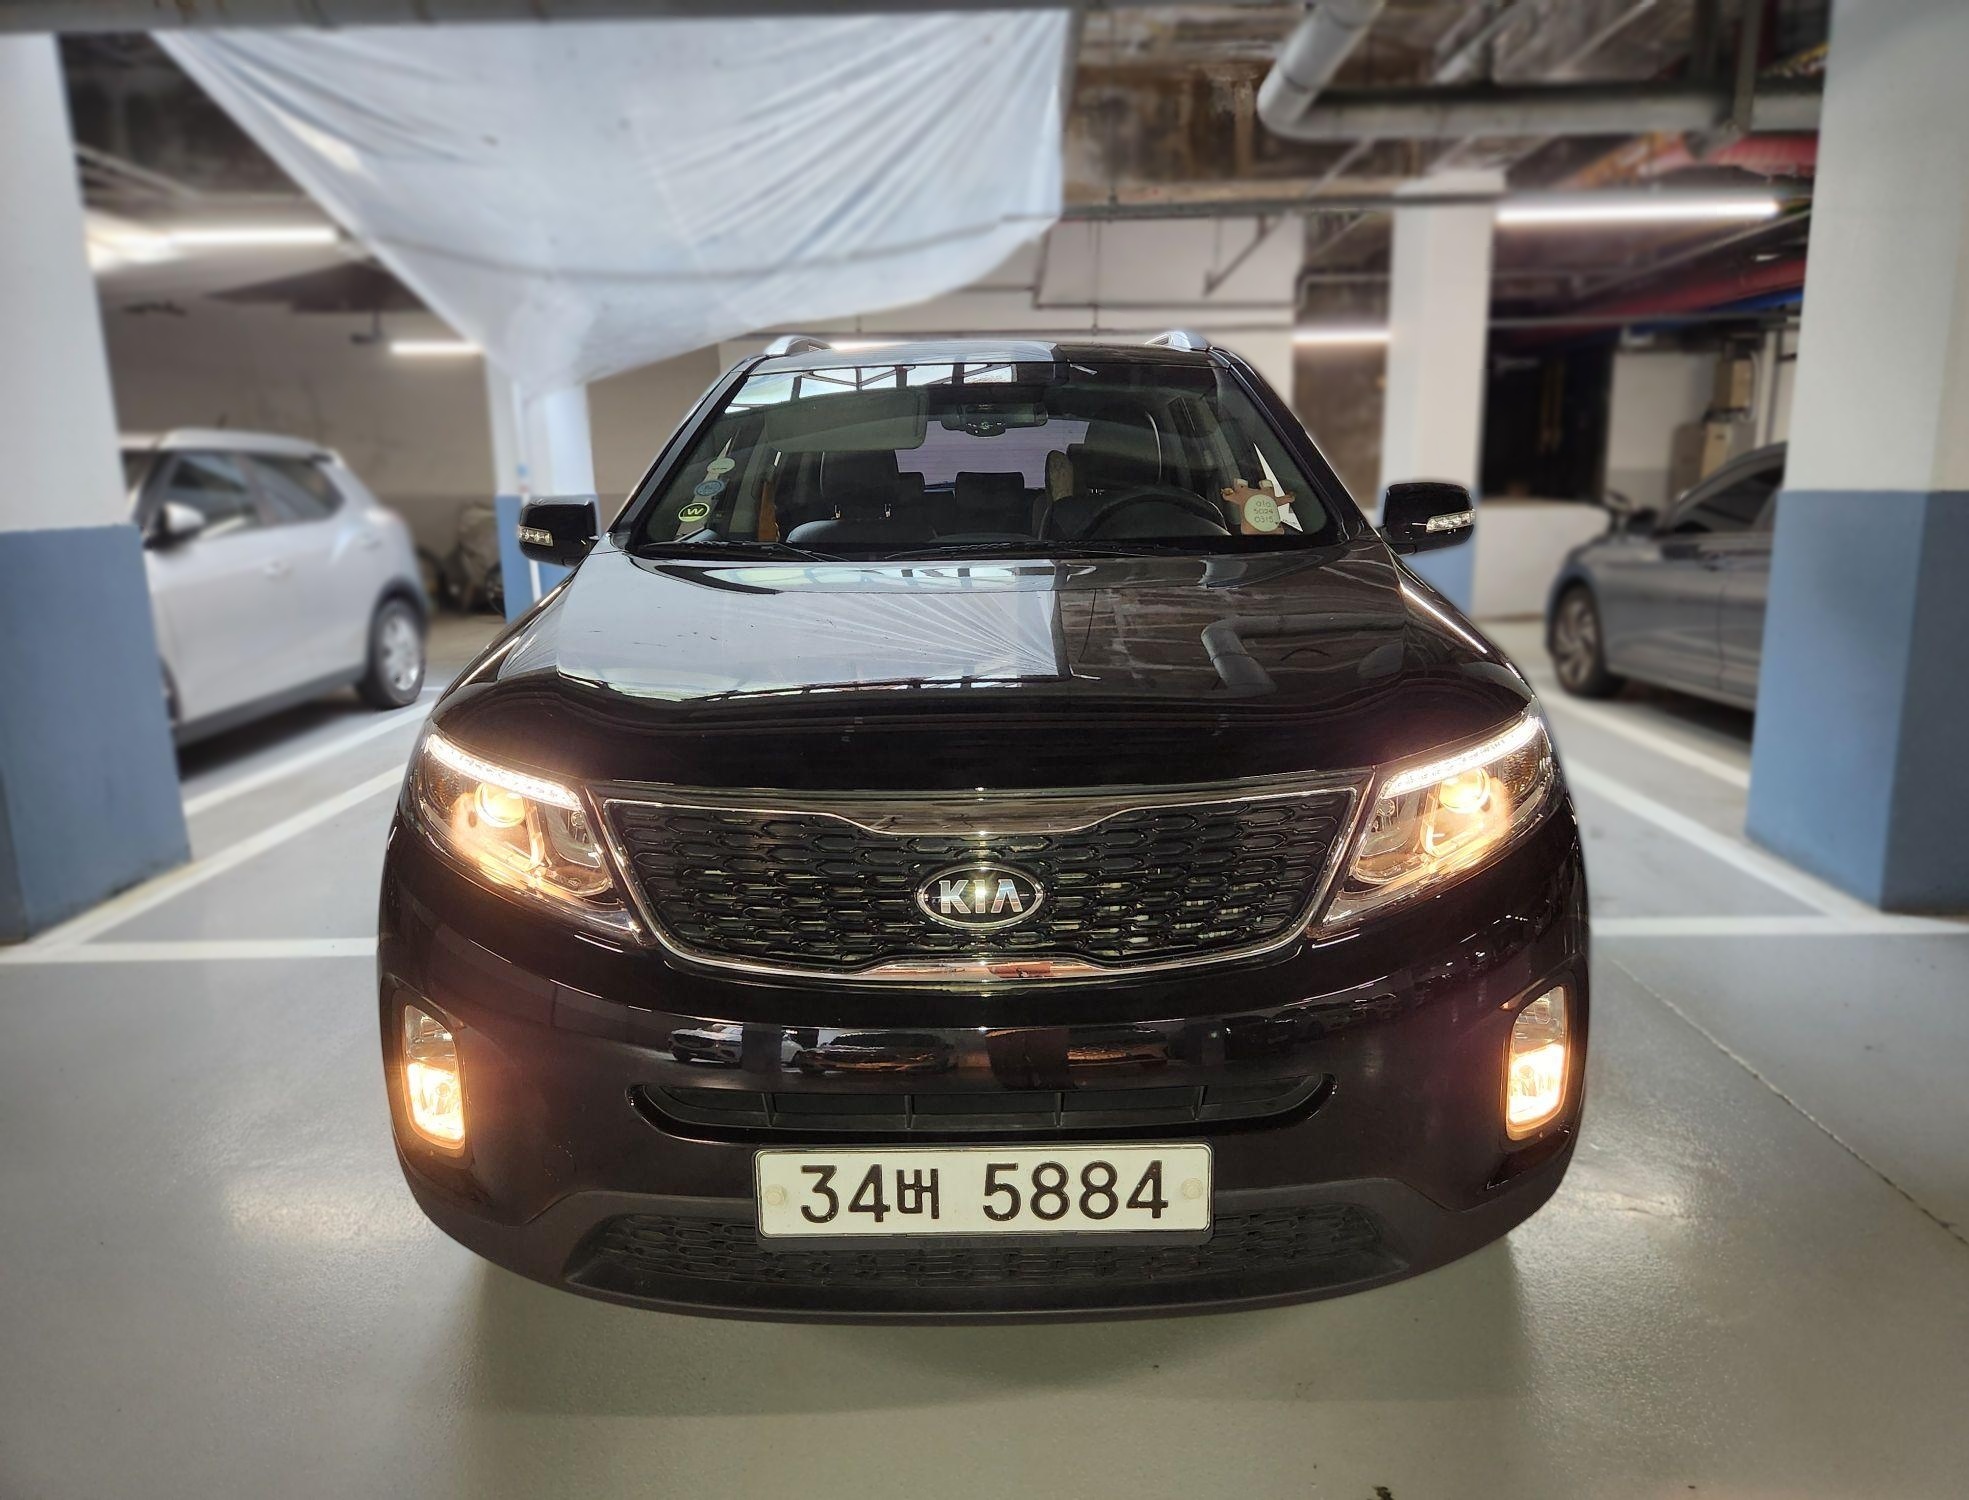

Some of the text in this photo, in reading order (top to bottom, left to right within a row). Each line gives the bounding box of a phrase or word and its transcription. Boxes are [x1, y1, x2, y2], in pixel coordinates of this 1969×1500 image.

[939, 879, 1024, 914] KIA
[801, 1160, 1169, 1223] 34버 5884
